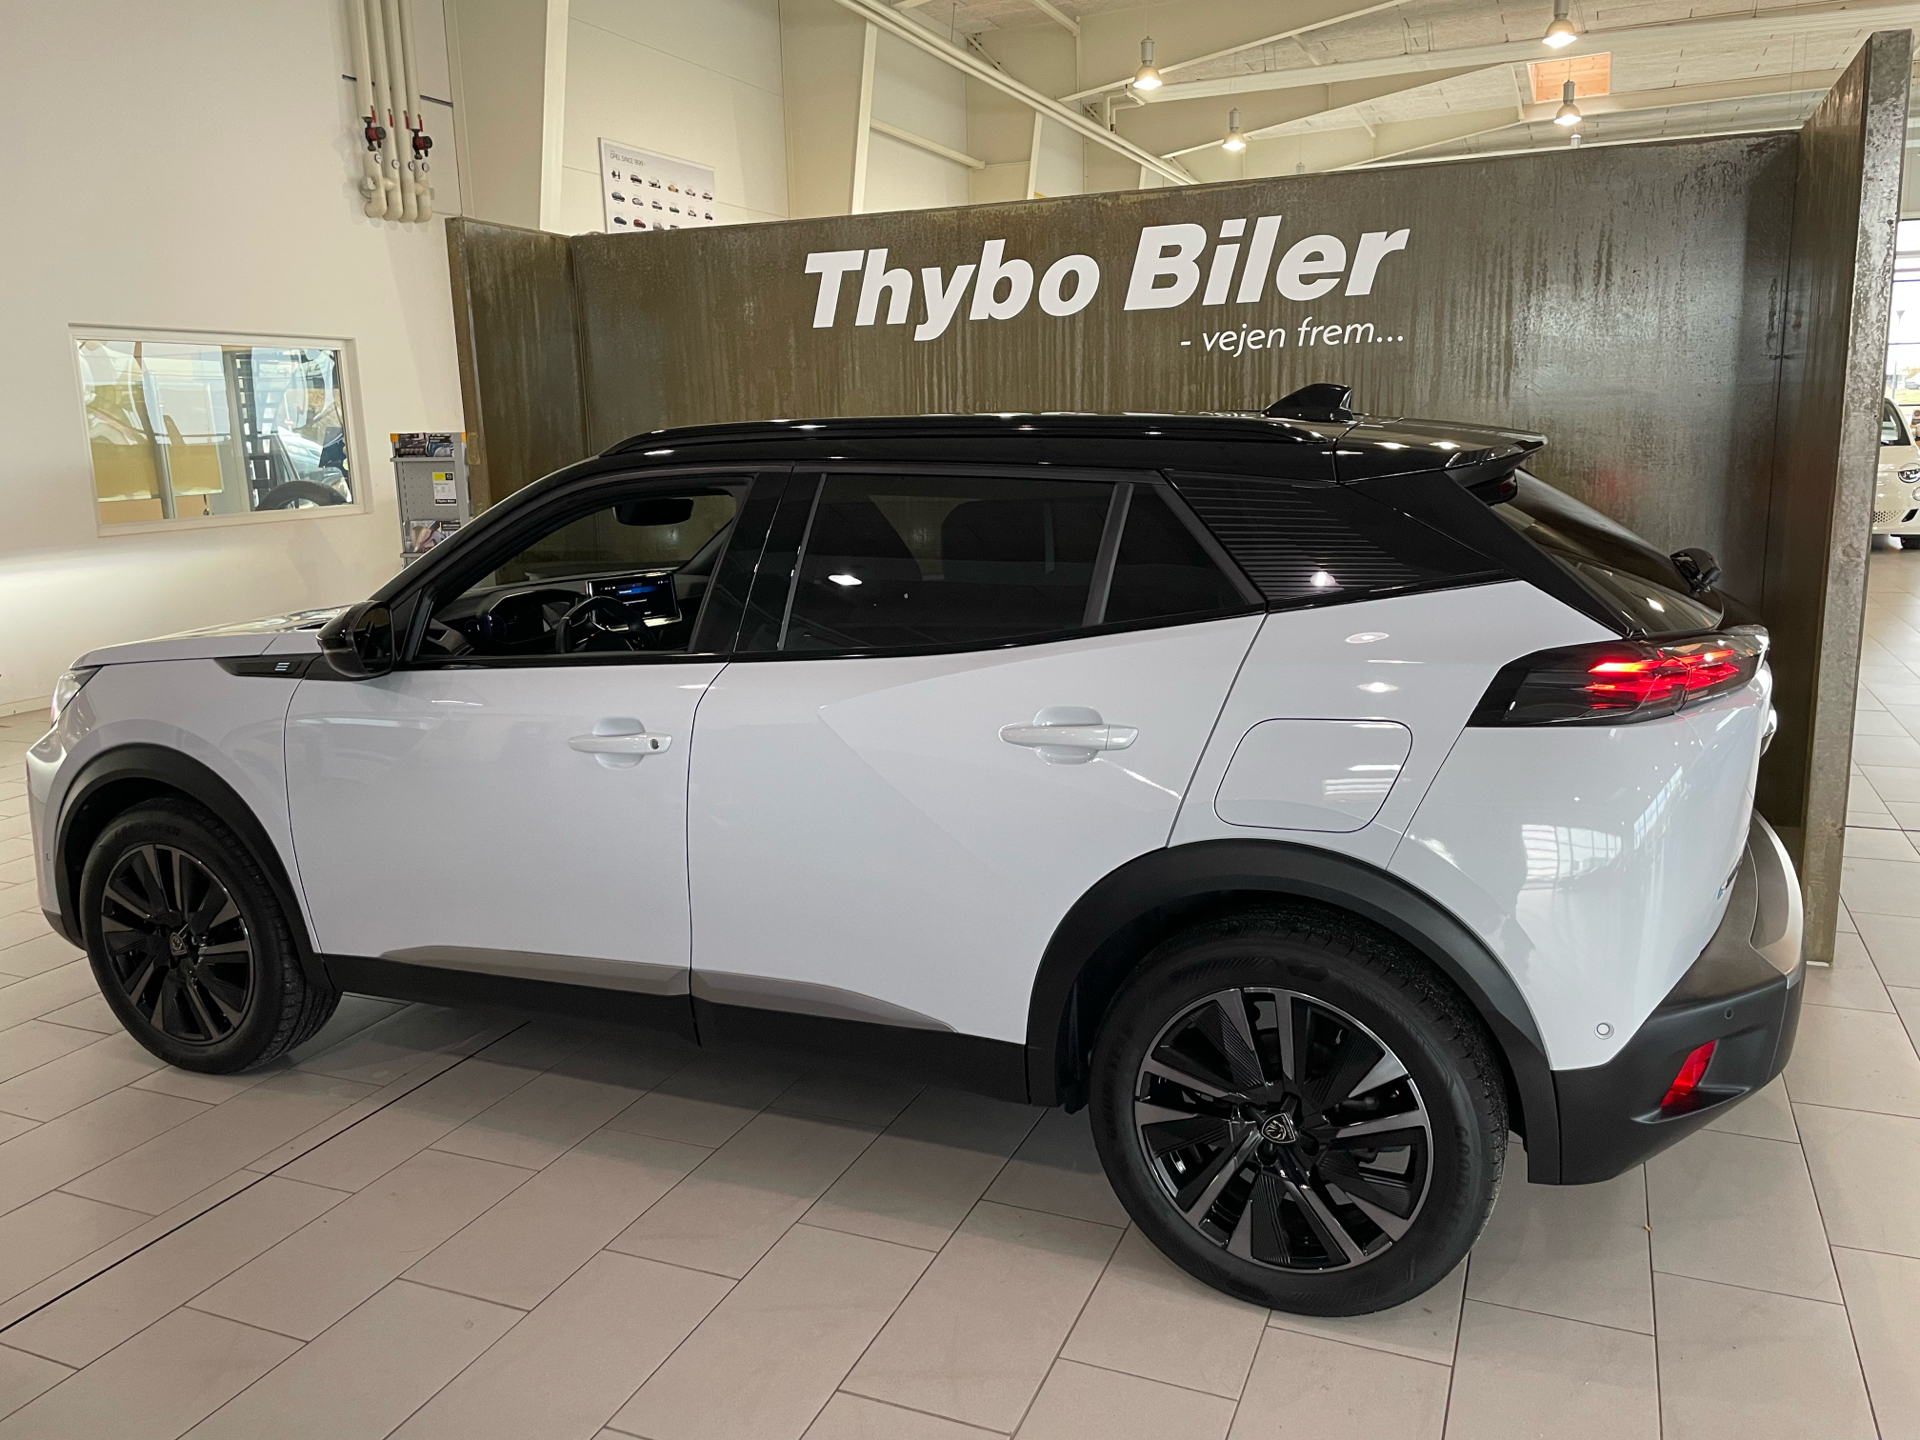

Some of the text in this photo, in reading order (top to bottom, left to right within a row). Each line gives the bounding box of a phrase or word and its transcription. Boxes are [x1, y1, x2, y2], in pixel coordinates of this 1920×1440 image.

[804, 214, 1411, 342] Thybo Biler
[1202, 327, 1286, 358] vejen
[1297, 316, 1404, 347] frem...
